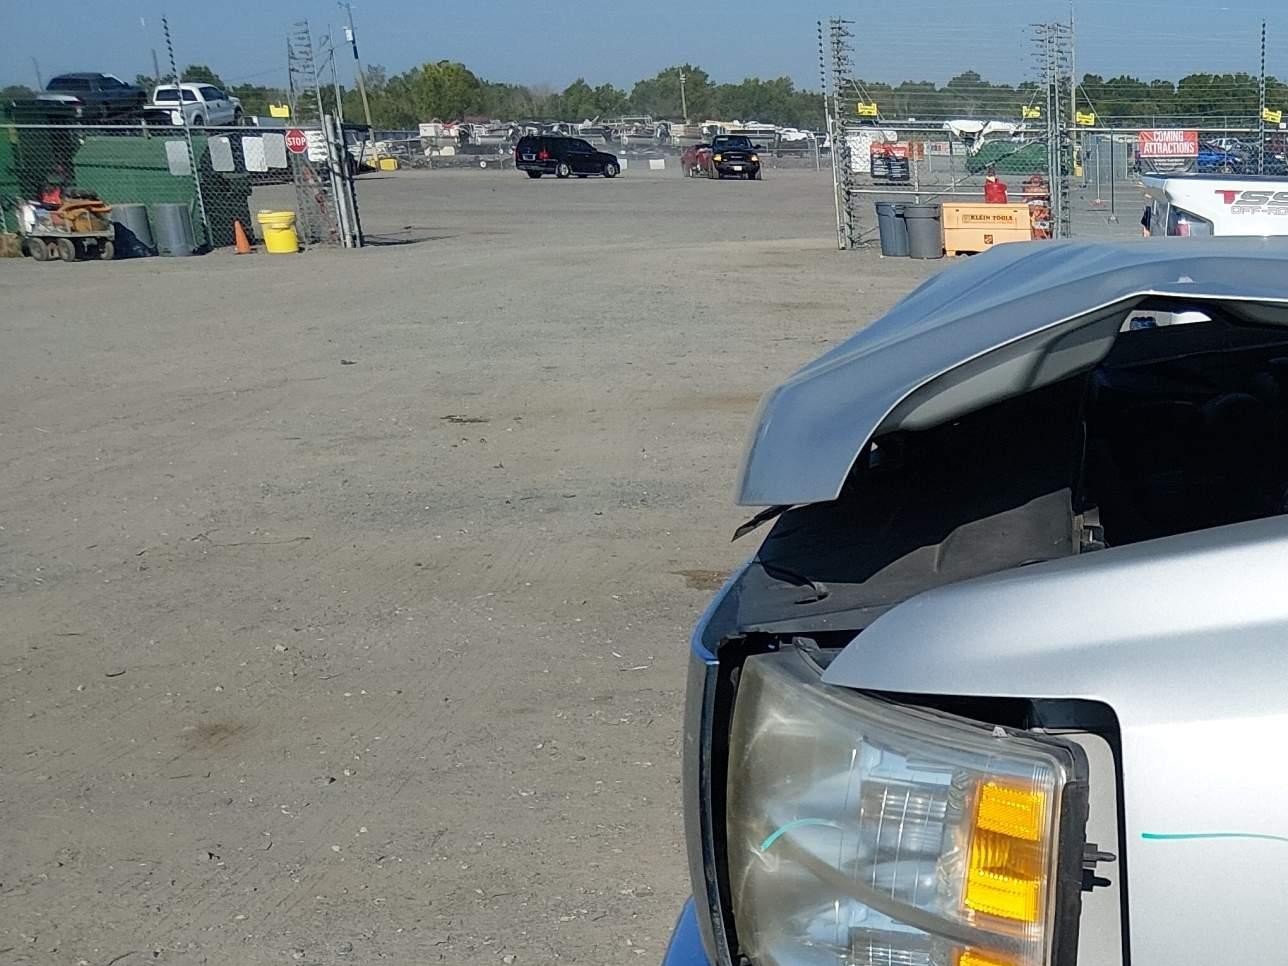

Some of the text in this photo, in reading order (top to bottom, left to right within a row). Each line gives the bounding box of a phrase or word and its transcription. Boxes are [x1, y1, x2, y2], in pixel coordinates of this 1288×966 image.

[287, 136, 306, 146] STOP
[1153, 130, 1184, 142] COMING
[1143, 142, 1195, 154] ATTRACTIONS
[970, 214, 1014, 222] KLEIN TOOLS
